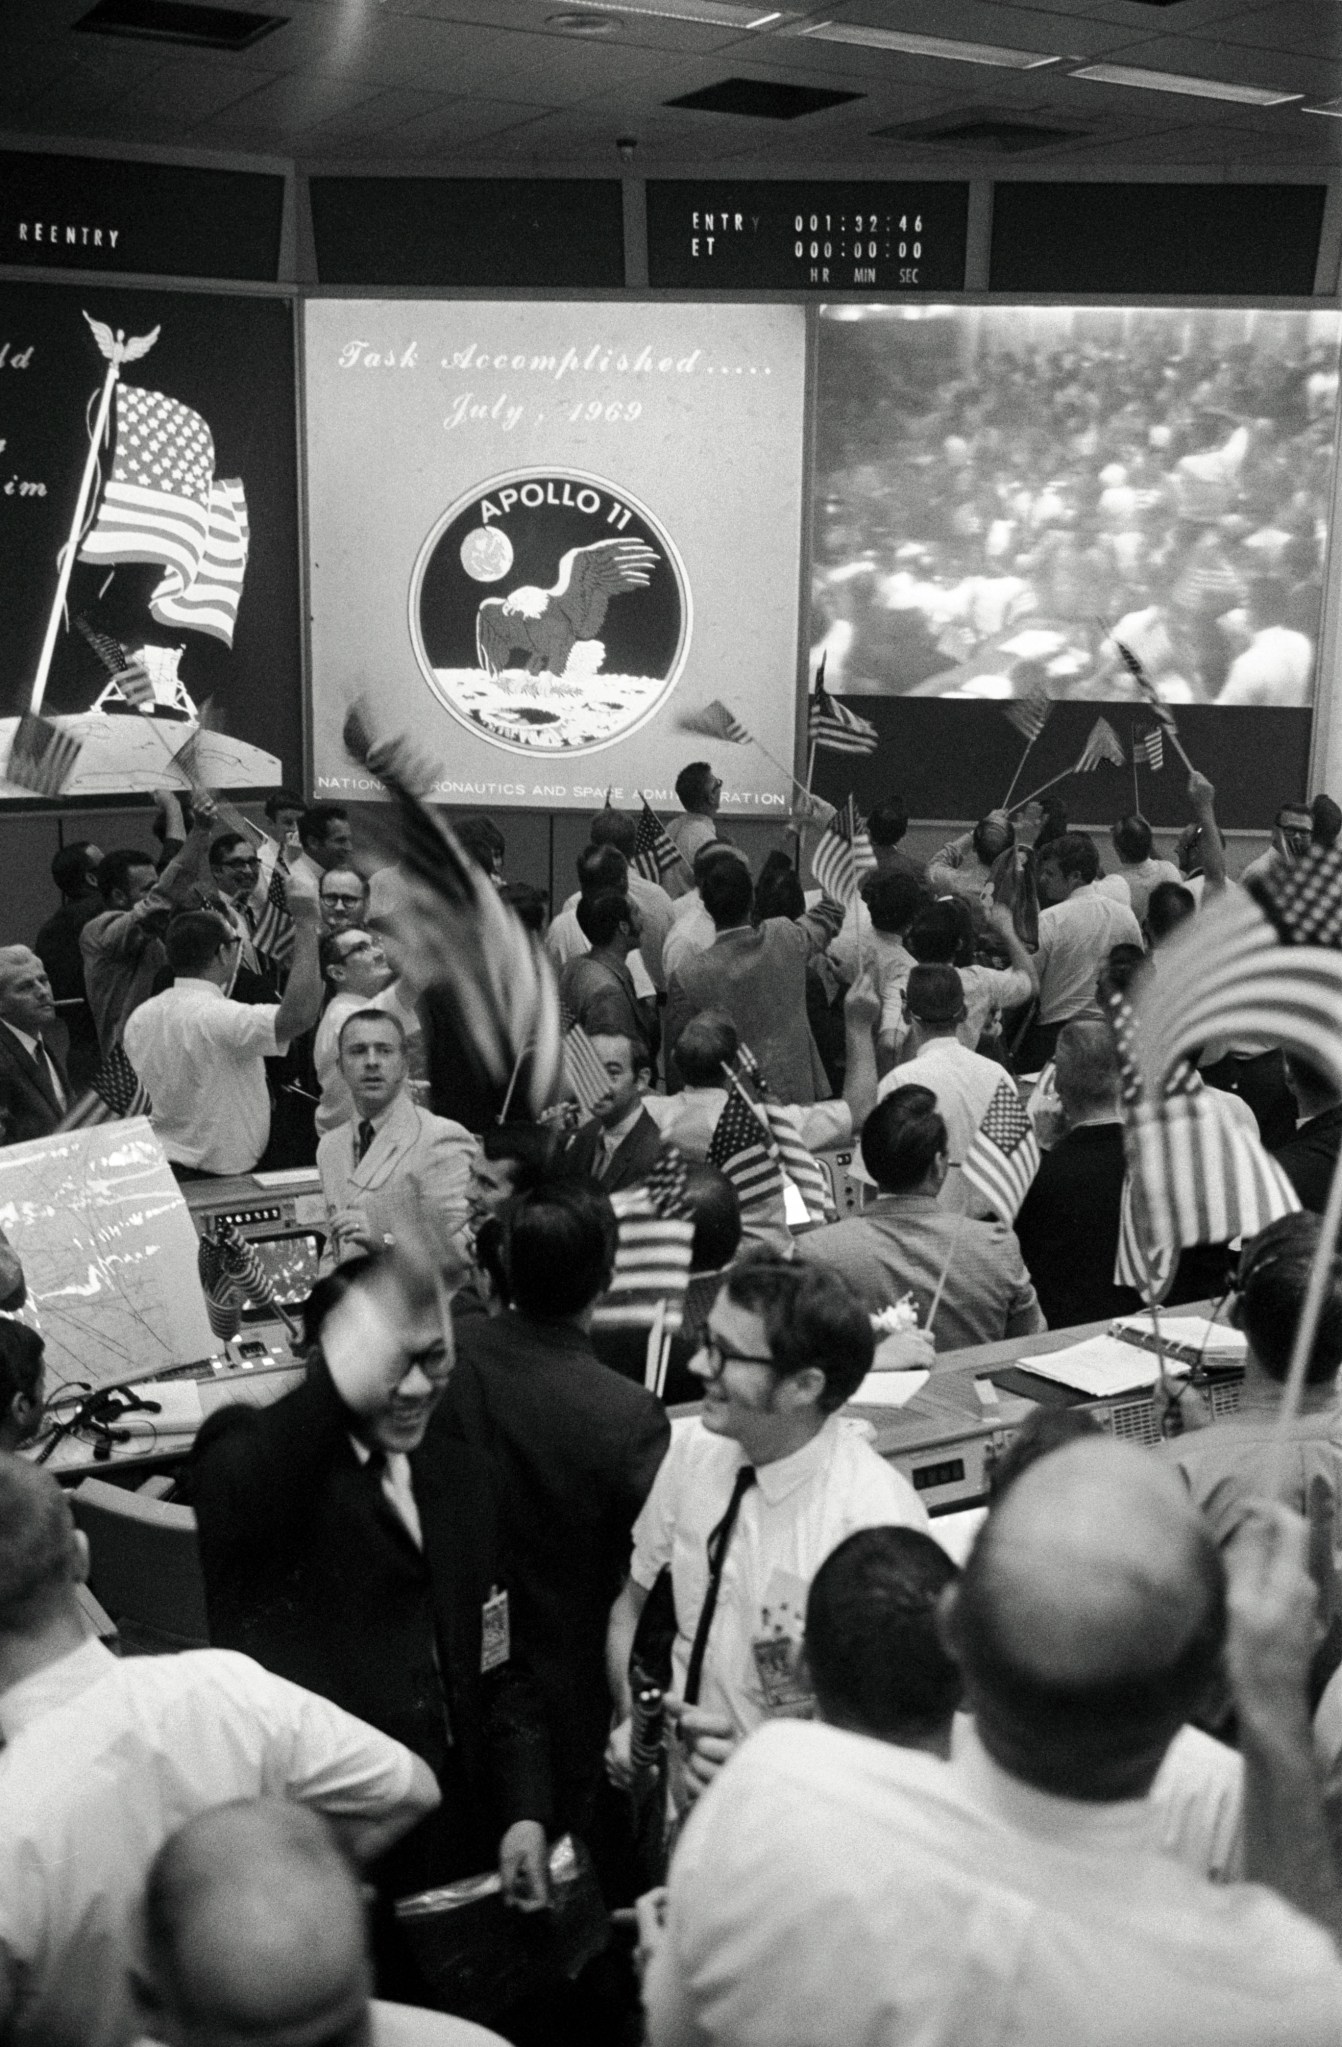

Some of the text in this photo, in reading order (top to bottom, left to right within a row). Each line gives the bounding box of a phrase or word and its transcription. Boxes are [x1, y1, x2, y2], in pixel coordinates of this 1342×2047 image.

[794, 214, 923, 233] 001:32:46
[19, 223, 119, 249] REENTRY
[691, 237, 922, 259] ET 000:00:00
[810, 267, 919, 284] HR MIN SEC
[338, 340, 417, 369] Task
[568, 400, 643, 423] 1969
[480, 482, 633, 531] APOLLO 11
[318, 776, 387, 791] NATION
[429, 780, 526, 796] RONAUTICS
[532, 784, 567, 797] AND
[632, 788, 786, 806] ADMIRATION
